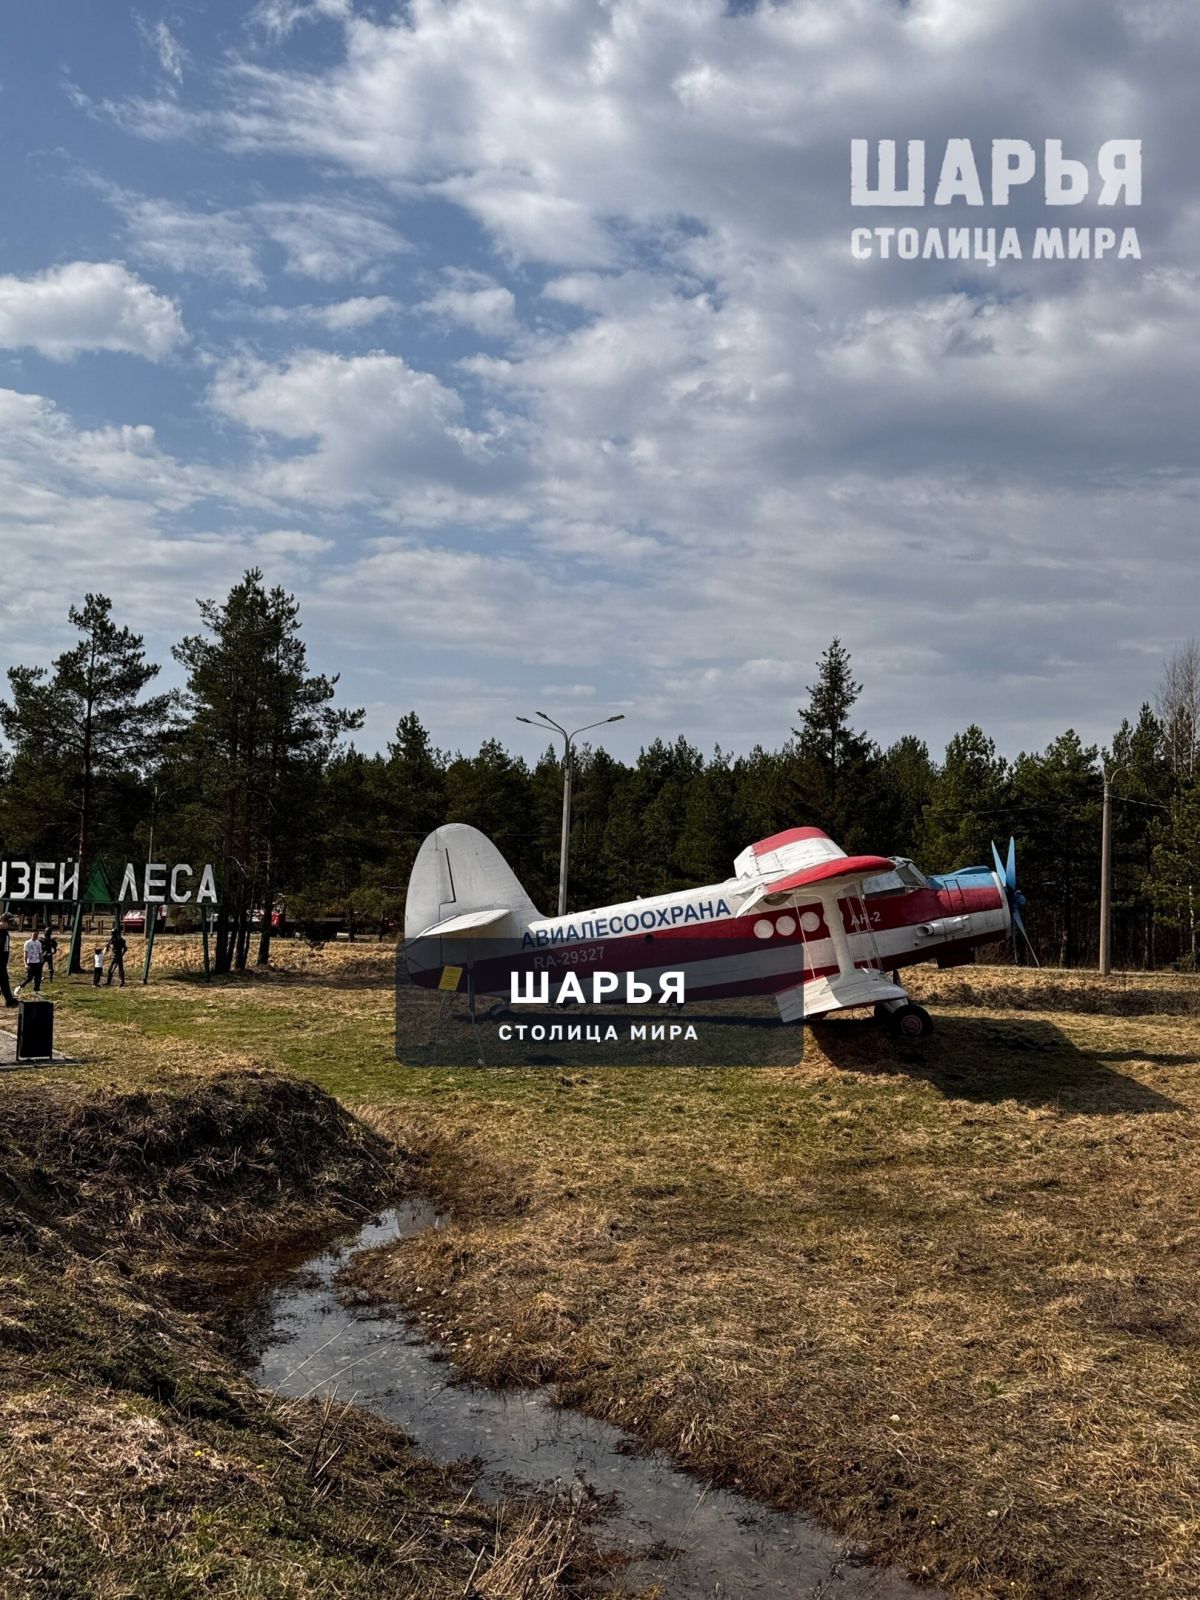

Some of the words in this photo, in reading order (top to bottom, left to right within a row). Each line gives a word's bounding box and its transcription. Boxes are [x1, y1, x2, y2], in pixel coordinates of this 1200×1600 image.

[119, 863, 218, 903] ЛЕСА
[522, 898, 731, 949] АВИАЛЕСООХРАНА
[851, 911, 881, 926] АН-2
[533, 946, 605, 969] RA-29327
